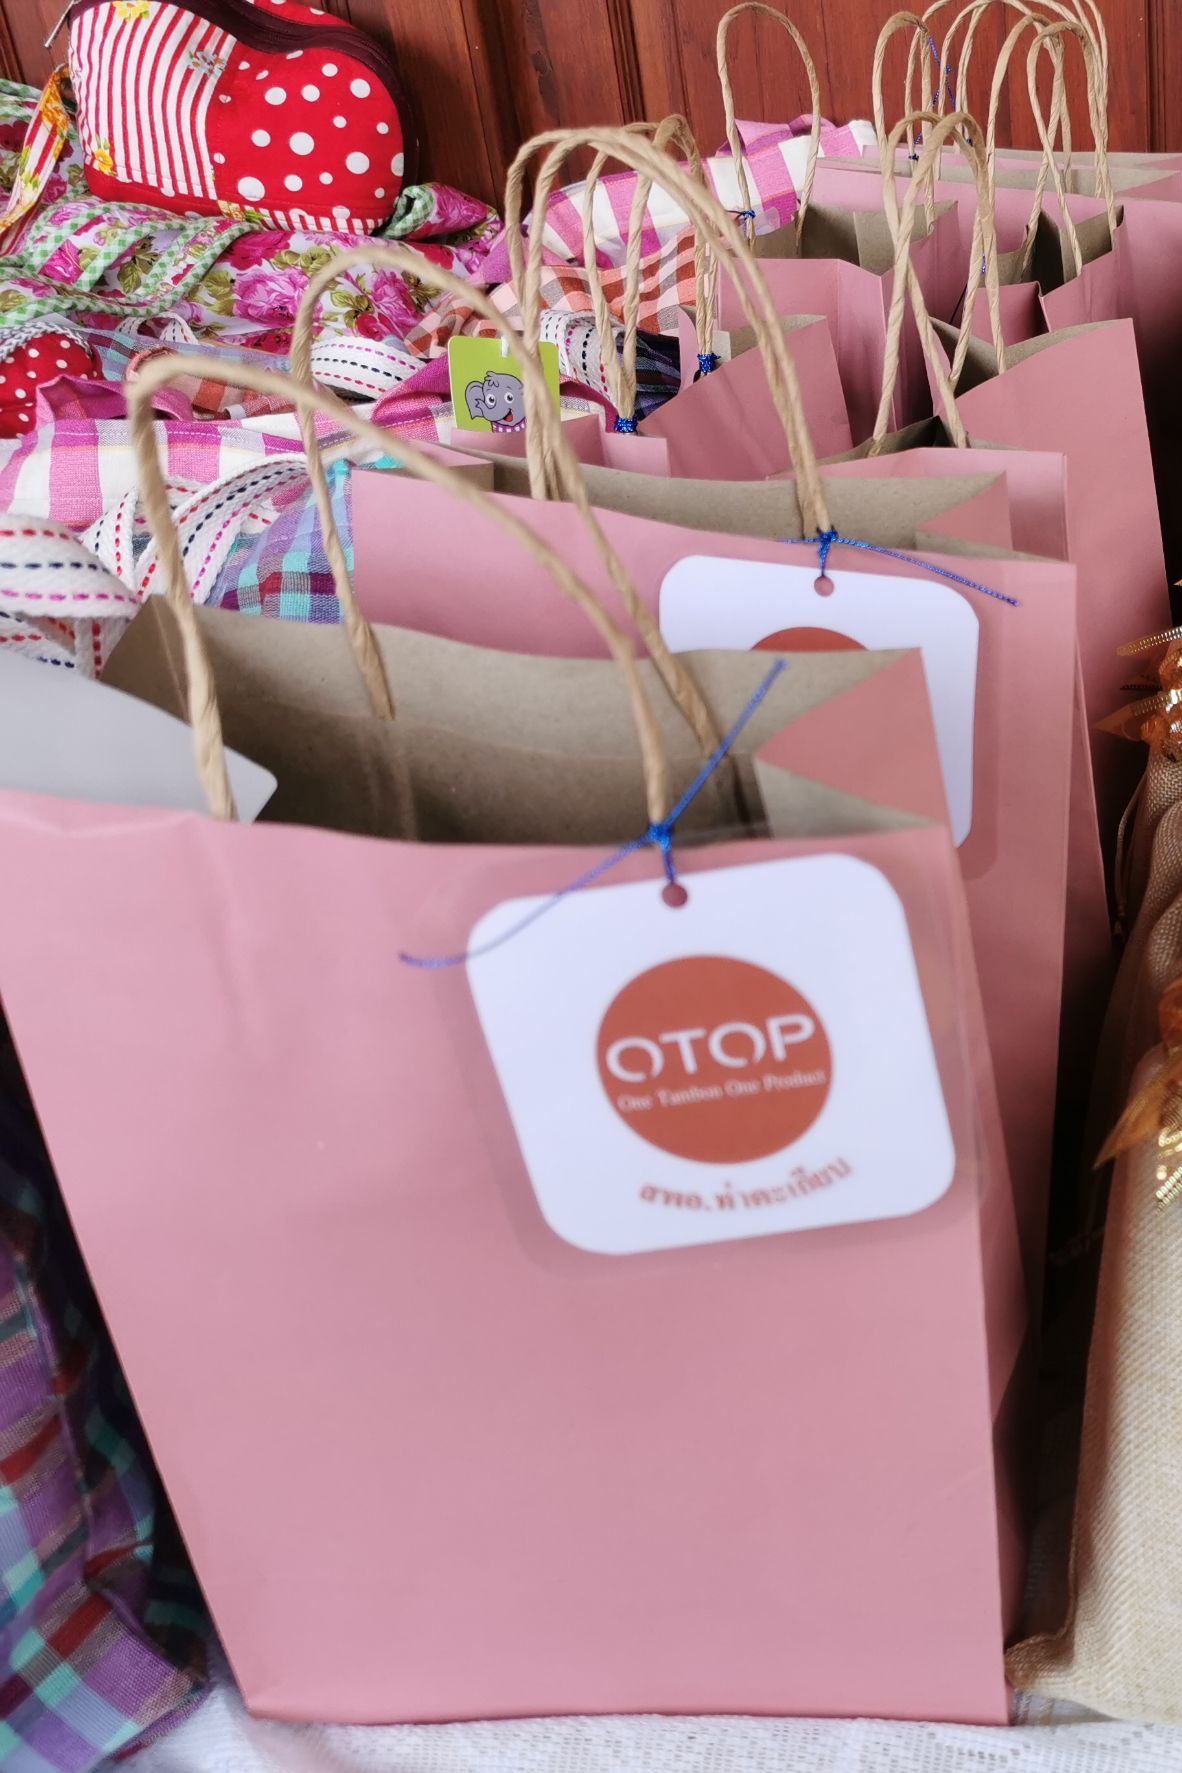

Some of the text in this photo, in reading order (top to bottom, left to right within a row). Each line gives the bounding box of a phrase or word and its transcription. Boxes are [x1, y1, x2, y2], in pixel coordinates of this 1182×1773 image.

[605, 1013, 816, 1083] OTOP
[617, 1069, 826, 1112] One Tambon One Product
